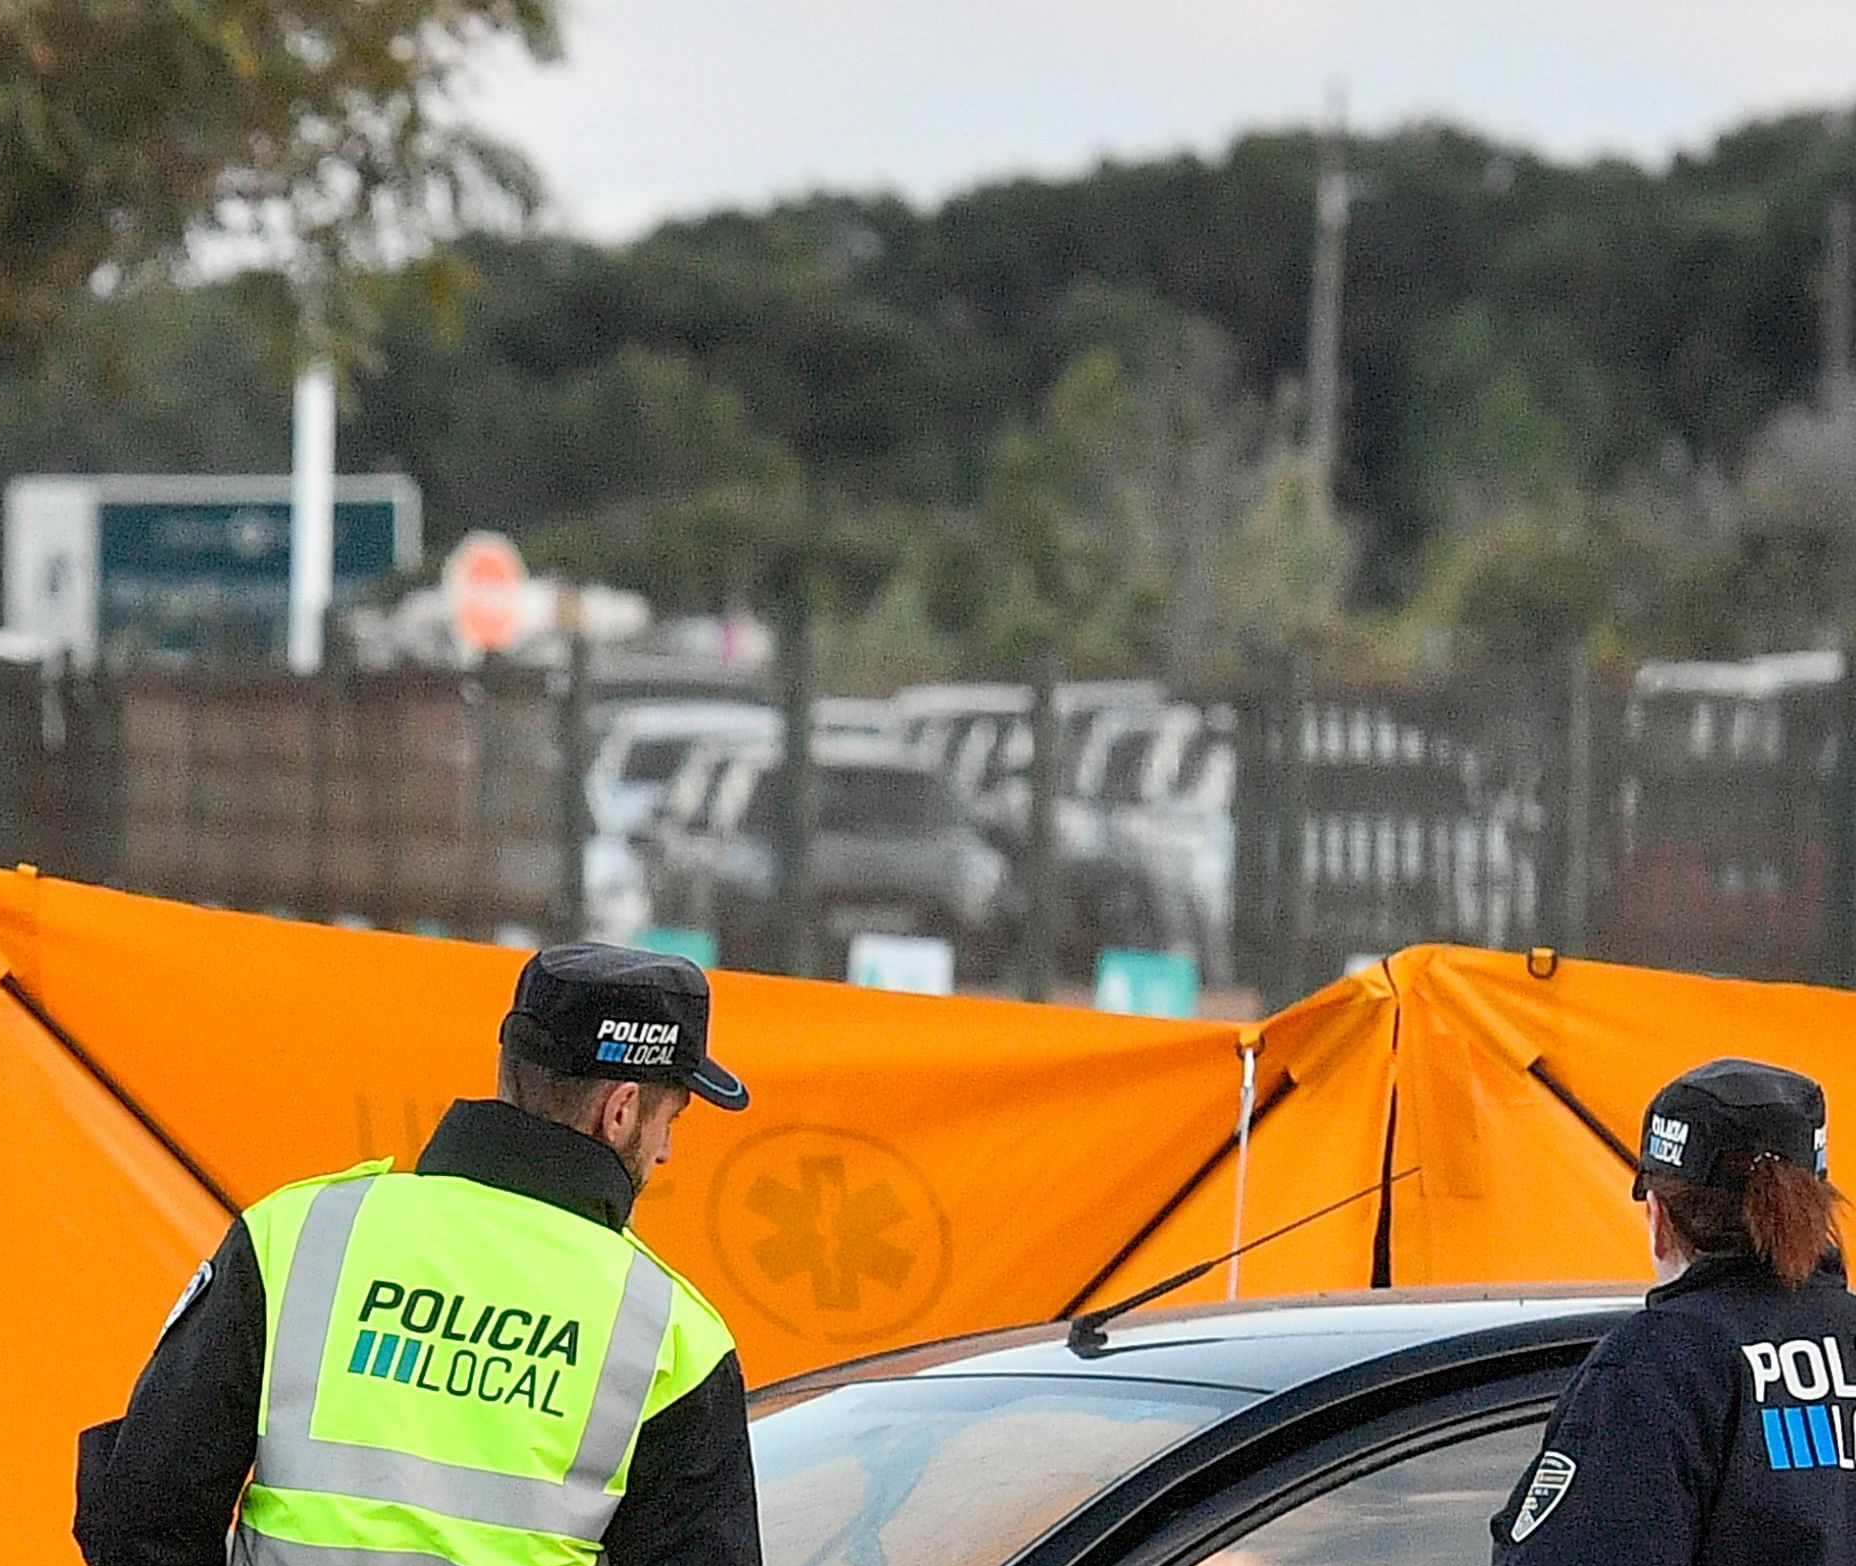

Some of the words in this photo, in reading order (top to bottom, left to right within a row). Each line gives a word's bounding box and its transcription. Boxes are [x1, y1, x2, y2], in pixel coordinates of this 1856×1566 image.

[597, 1019, 680, 1045] POLICIA
[623, 1044, 677, 1066] LOCAL
[357, 1279, 581, 1367] POLICIA
[416, 1343, 565, 1418] LOCAL
